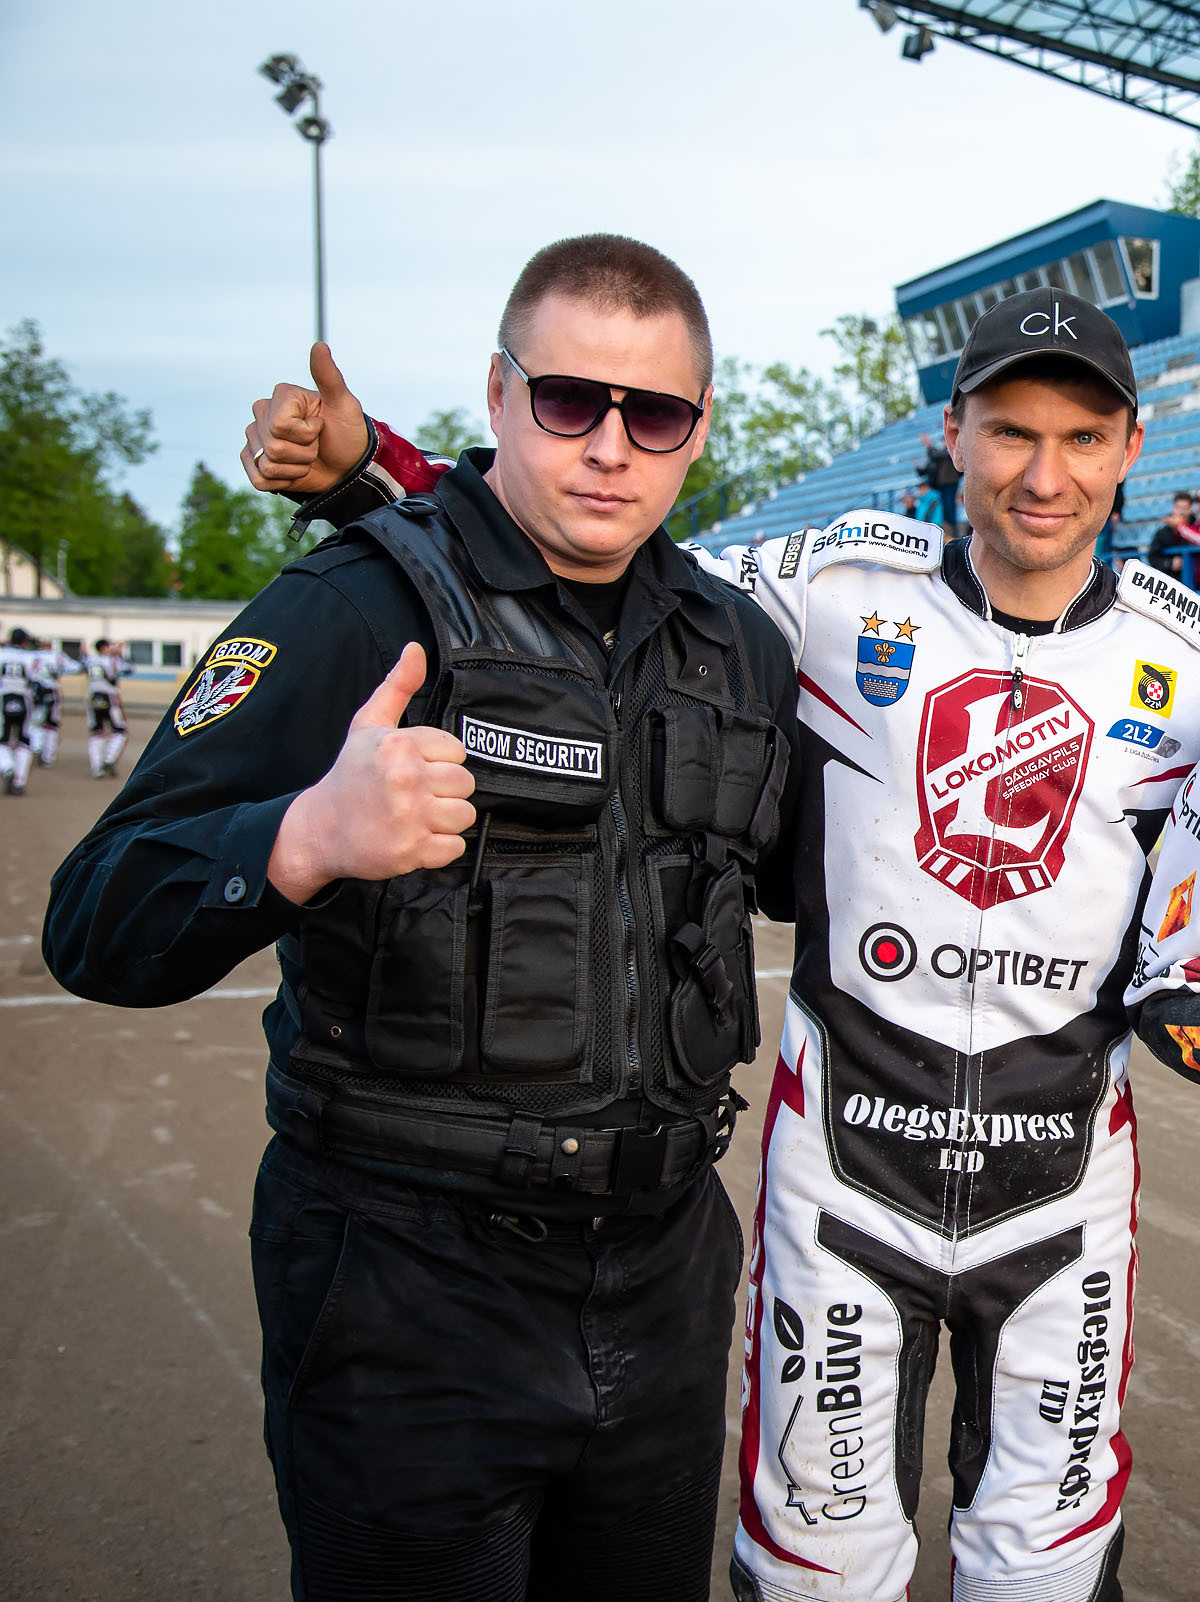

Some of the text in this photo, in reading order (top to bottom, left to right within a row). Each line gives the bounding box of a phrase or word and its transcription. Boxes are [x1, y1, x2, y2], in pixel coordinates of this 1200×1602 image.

[1019, 302, 1078, 340] ck
[811, 521, 930, 554] SemiCom
[215, 643, 269, 661] GROM
[466, 724, 598, 773] GROM SECURITY
[930, 710, 1070, 799] LOKOMOTIV
[1004, 741, 1080, 787] DAUGAVPILS
[1002, 756, 1077, 800] SPEEDWAY CLUB
[931, 944, 1089, 991] OPTIBET
[843, 1093, 1075, 1147] OlegsExpress
[938, 1148, 985, 1173] LTD
[815, 1302, 867, 1522] GreenBūve
[1038, 1378, 1071, 1424] LTD
[1055, 1270, 1112, 1511] OlegsExpress
